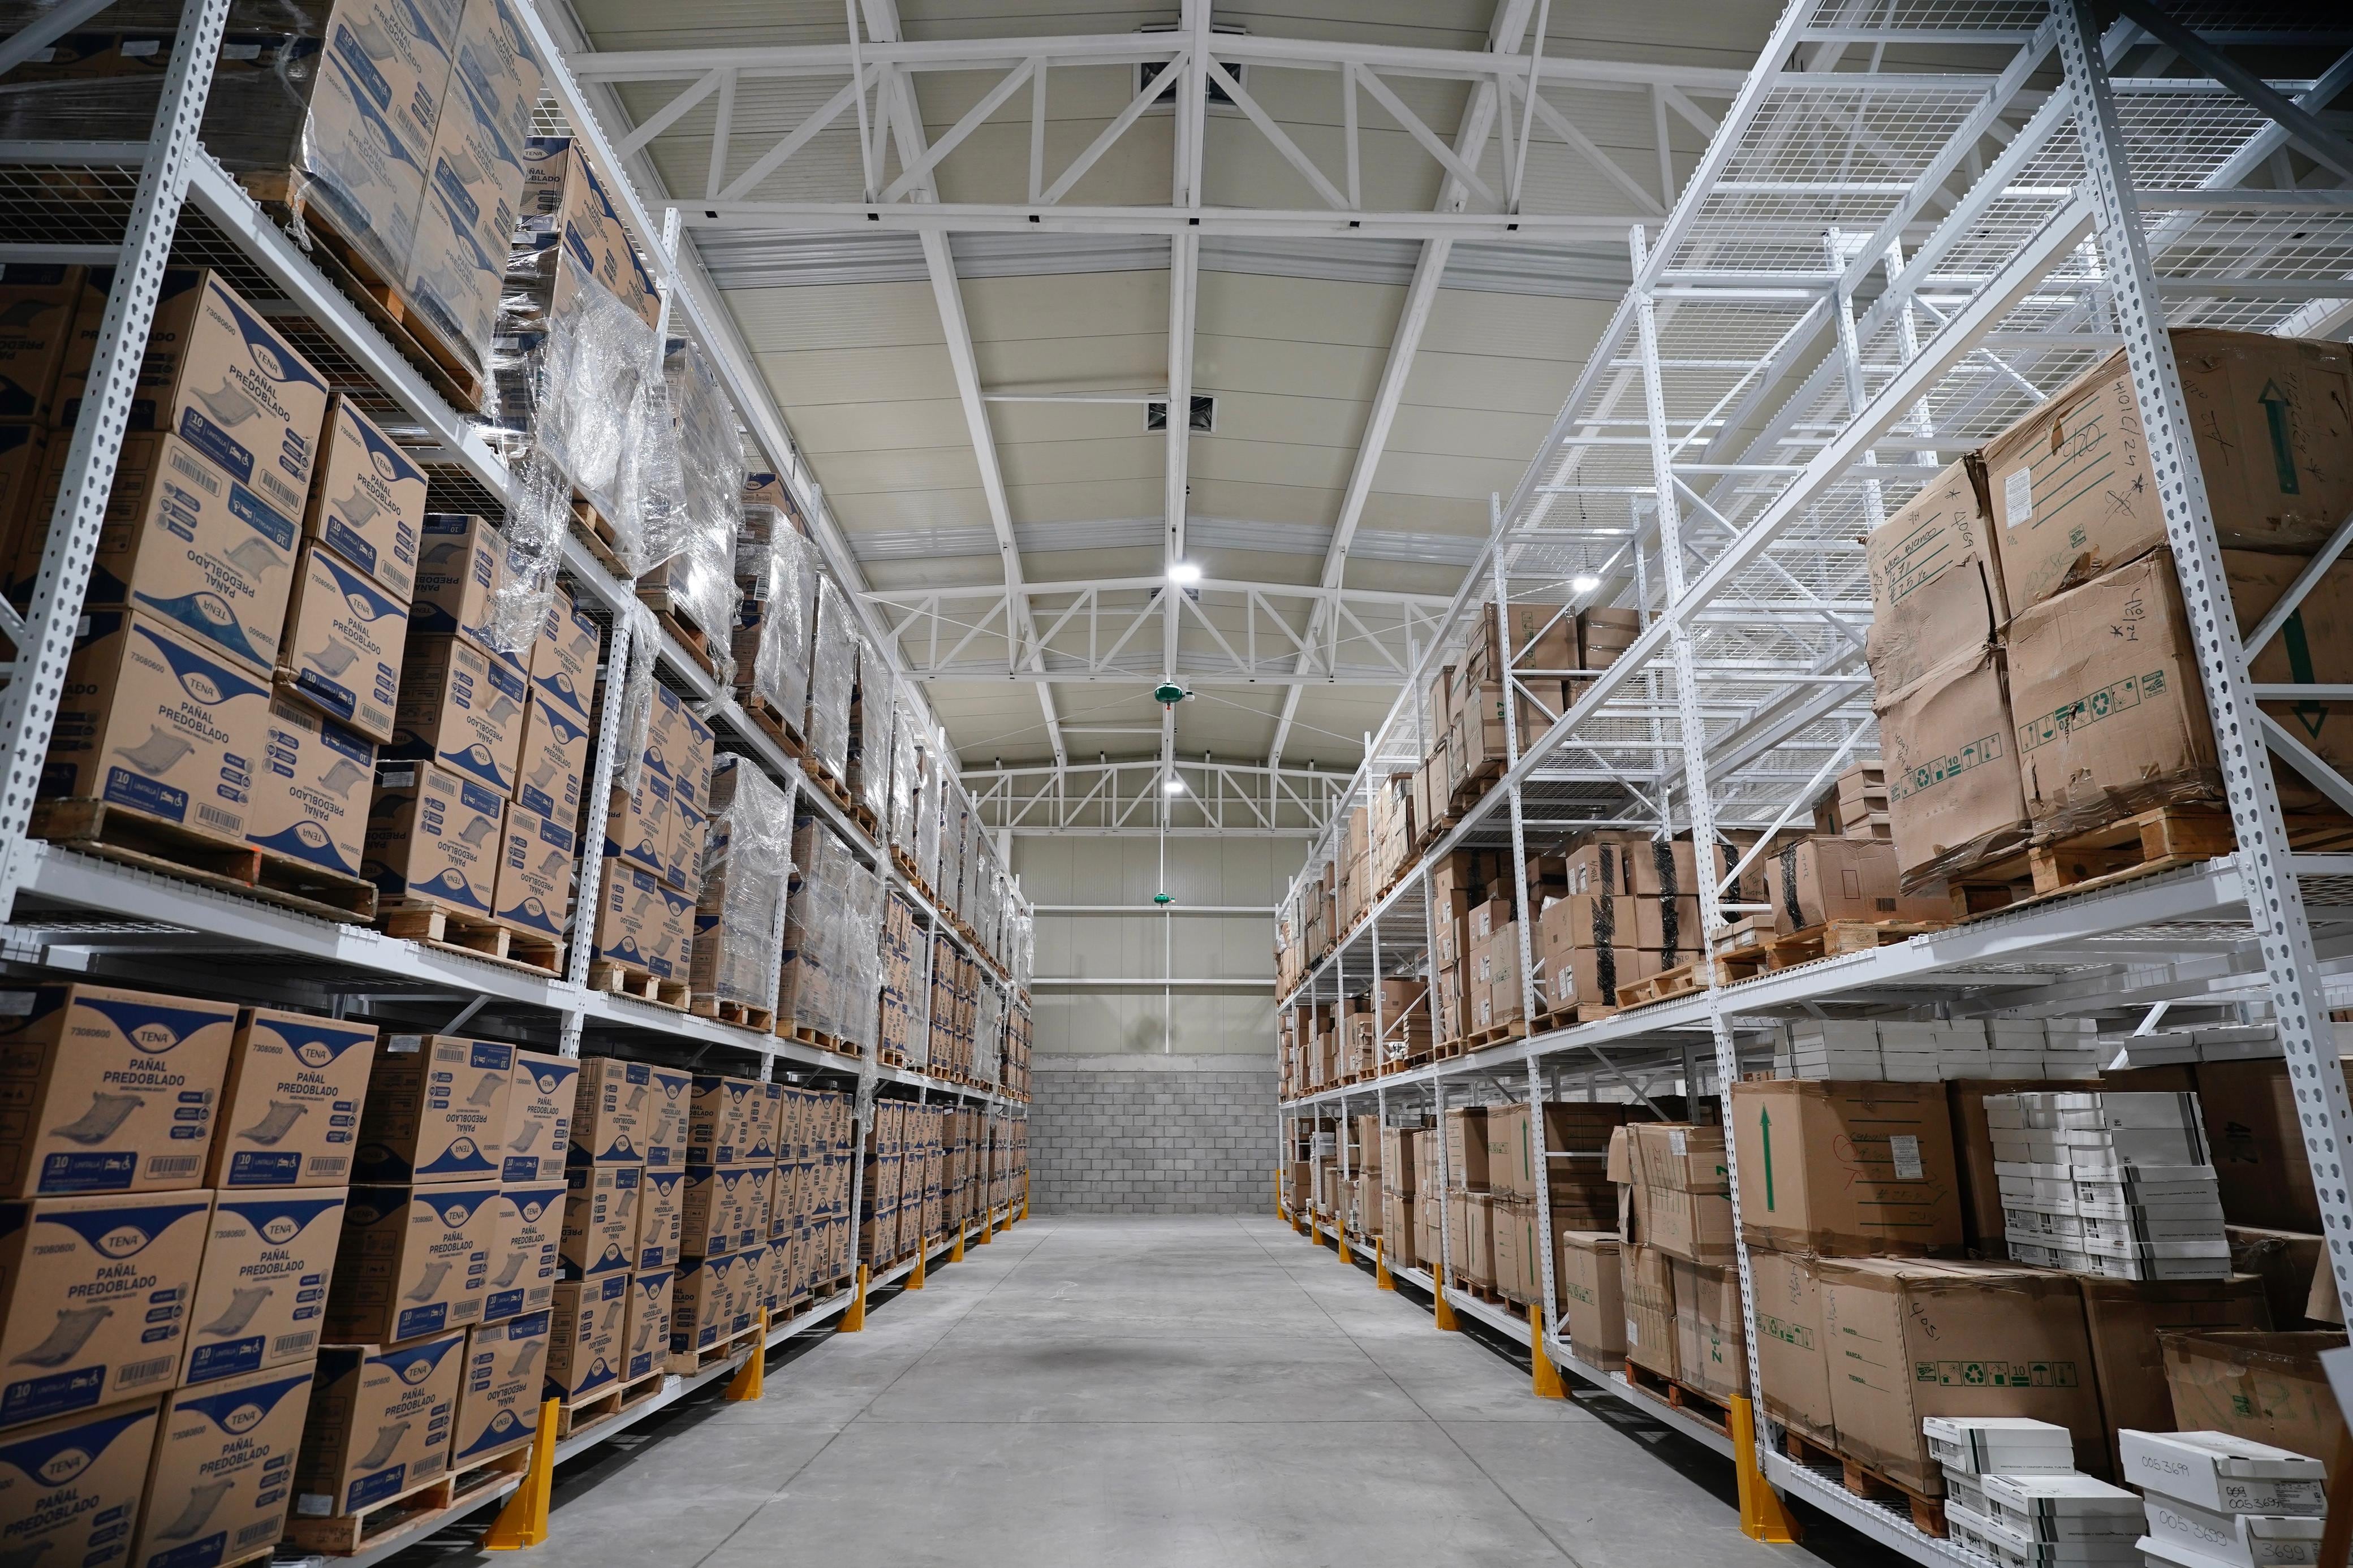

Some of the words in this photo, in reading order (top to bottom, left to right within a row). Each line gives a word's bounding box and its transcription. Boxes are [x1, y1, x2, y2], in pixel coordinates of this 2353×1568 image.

[374, 3, 422, 74] PREDOBLADO
[390, 14, 412, 50] PAÑAL
[488, 27, 522, 87] PREDOBLADO
[368, 122, 386, 148] TENA
[364, 137, 387, 169] PAÑAL
[348, 129, 397, 194] PREDOBLADO
[466, 134, 502, 191] PREDOBLADO
[584, 200, 608, 243] PREDOBLADO
[446, 249, 482, 301] PREDOBLADO
[206, 305, 236, 335] 73080600
[257, 349, 279, 373] TENA
[249, 368, 277, 399] PAÑAL
[229, 365, 290, 422] PREDOBLADO
[193, 413, 204, 428] 10
[341, 425, 361, 448] 73080600
[376, 456, 392, 474] TENA
[370, 474, 391, 498] PAÑAL
[357, 473, 401, 516] PREDOBLADO
[333, 522, 342, 532] 10
[187, 550, 255, 598] PREDOBLADO
[205, 572, 235, 598] PAÑAL
[312, 573, 336, 593] 73080600
[202, 599, 226, 620] TENA
[354, 598, 370, 615] TENA
[348, 617, 370, 638] PAÑAL
[248, 626, 275, 646] 73080600
[333, 619, 381, 655] PREDOBLADO
[131, 652, 164, 673] 73080600
[554, 647, 581, 673] PREDOBLADO
[561, 660, 574, 675] PAÑAL
[308, 673, 316, 683] 10
[190, 678, 214, 697] TENA
[181, 702, 213, 724] PAÑAL
[158, 705, 229, 743] PREDOBLADO
[467, 716, 502, 742] PREDOBLADO
[476, 731, 492, 744] PAÑAL
[556, 728, 566, 738] TENA
[475, 750, 488, 761] TENA
[544, 746, 571, 768] PREDOBLADO
[552, 744, 565, 757] PAÑAL
[1947, 756, 1958, 766] 10
[117, 771, 129, 784] 10
[290, 787, 344, 817] PREDOBLADO
[304, 804, 329, 821] PAÑAL
[303, 828, 322, 843] TENA
[438, 841, 477, 862] PREDOBLADO
[448, 856, 466, 867] PAÑAL
[446, 875, 461, 884] TENA
[521, 874, 553, 891] PREDOBLADO
[529, 884, 544, 896] PAÑAL
[528, 903, 540, 912] TENA
[71, 1027, 111, 1039] 73080600
[140, 1031, 168, 1043] TENA
[253, 1044, 283, 1054] 73080600
[305, 1049, 326, 1059] TENA
[130, 1057, 167, 1072] PAÑAL
[103, 1072, 185, 1086] PREDOBLADO
[296, 1072, 325, 1083] PAÑAL
[277, 1083, 338, 1096] PREDOBLADO
[537, 1096, 552, 1106] PAÑAL
[527, 1105, 559, 1115] PREDOBLADO
[446, 1114, 487, 1122] PREDOBLADO
[457, 1124, 475, 1134] PAÑAL
[55, 1156, 68, 1168] 10
[240, 1155, 251, 1164] 10
[449, 1211, 464, 1220] TENA
[270, 1225, 292, 1234] TENA
[443, 1232, 463, 1242] PAÑAL
[522, 1225, 537, 1235] PAÑAL
[109, 1235, 140, 1247] TENA
[511, 1234, 544, 1245] PREDOBLADO
[429, 1241, 473, 1254] PREDOBLADO
[260, 1249, 290, 1262] PAÑAL
[97, 1263, 137, 1280] PAÑAL
[240, 1260, 304, 1277] PREDOBLADO
[68, 1276, 157, 1298] PREDOBLADO
[643, 1308, 662, 1319] PREDOBLADO
[1843, 1327, 1858, 1336] PARES:
[1846, 1350, 1862, 1360] MARCA:
[410, 1366, 428, 1377] TENA
[2013, 1366, 2025, 1376] 10
[1848, 1373, 1866, 1385] TIENDA:
[16, 1384, 31, 1396] 10
[401, 1388, 425, 1401] PAÑAL
[488, 1383, 527, 1401] PREDOBLADO
[385, 1394, 436, 1416] PREDOBLADO
[498, 1395, 515, 1407] PAÑAL
[231, 1411, 256, 1425] TENA
[496, 1418, 510, 1428] TENA
[222, 1437, 254, 1455] PAÑAL
[49, 1456, 81, 1475] TENA
[199, 1445, 270, 1475] PREDOBLADO
[35, 1488, 79, 1512] PAÑAL
[3, 1495, 100, 1538] PREDOBLADO
[2261, 1543, 2305, 1561] 3699
